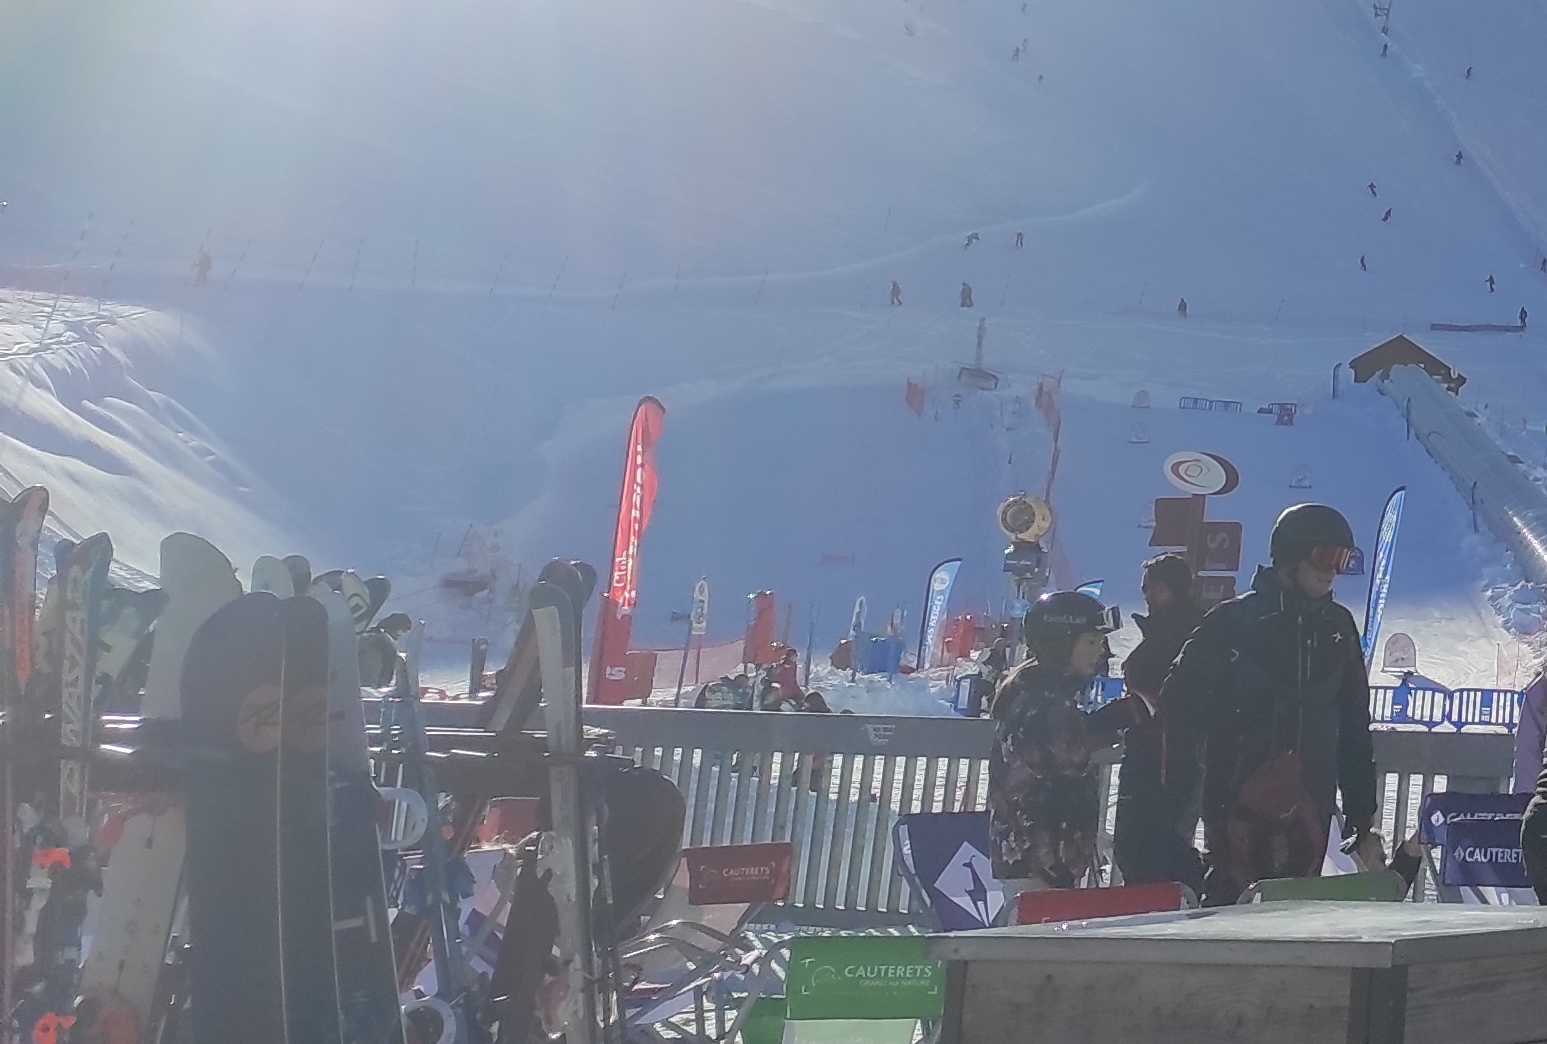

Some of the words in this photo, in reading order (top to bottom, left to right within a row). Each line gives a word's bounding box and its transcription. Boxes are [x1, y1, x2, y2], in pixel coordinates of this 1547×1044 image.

[1465, 846, 1523, 864] CAUTERET
[722, 866, 771, 877] CAUTERETS
[844, 965, 933, 979] CAUTERETS
